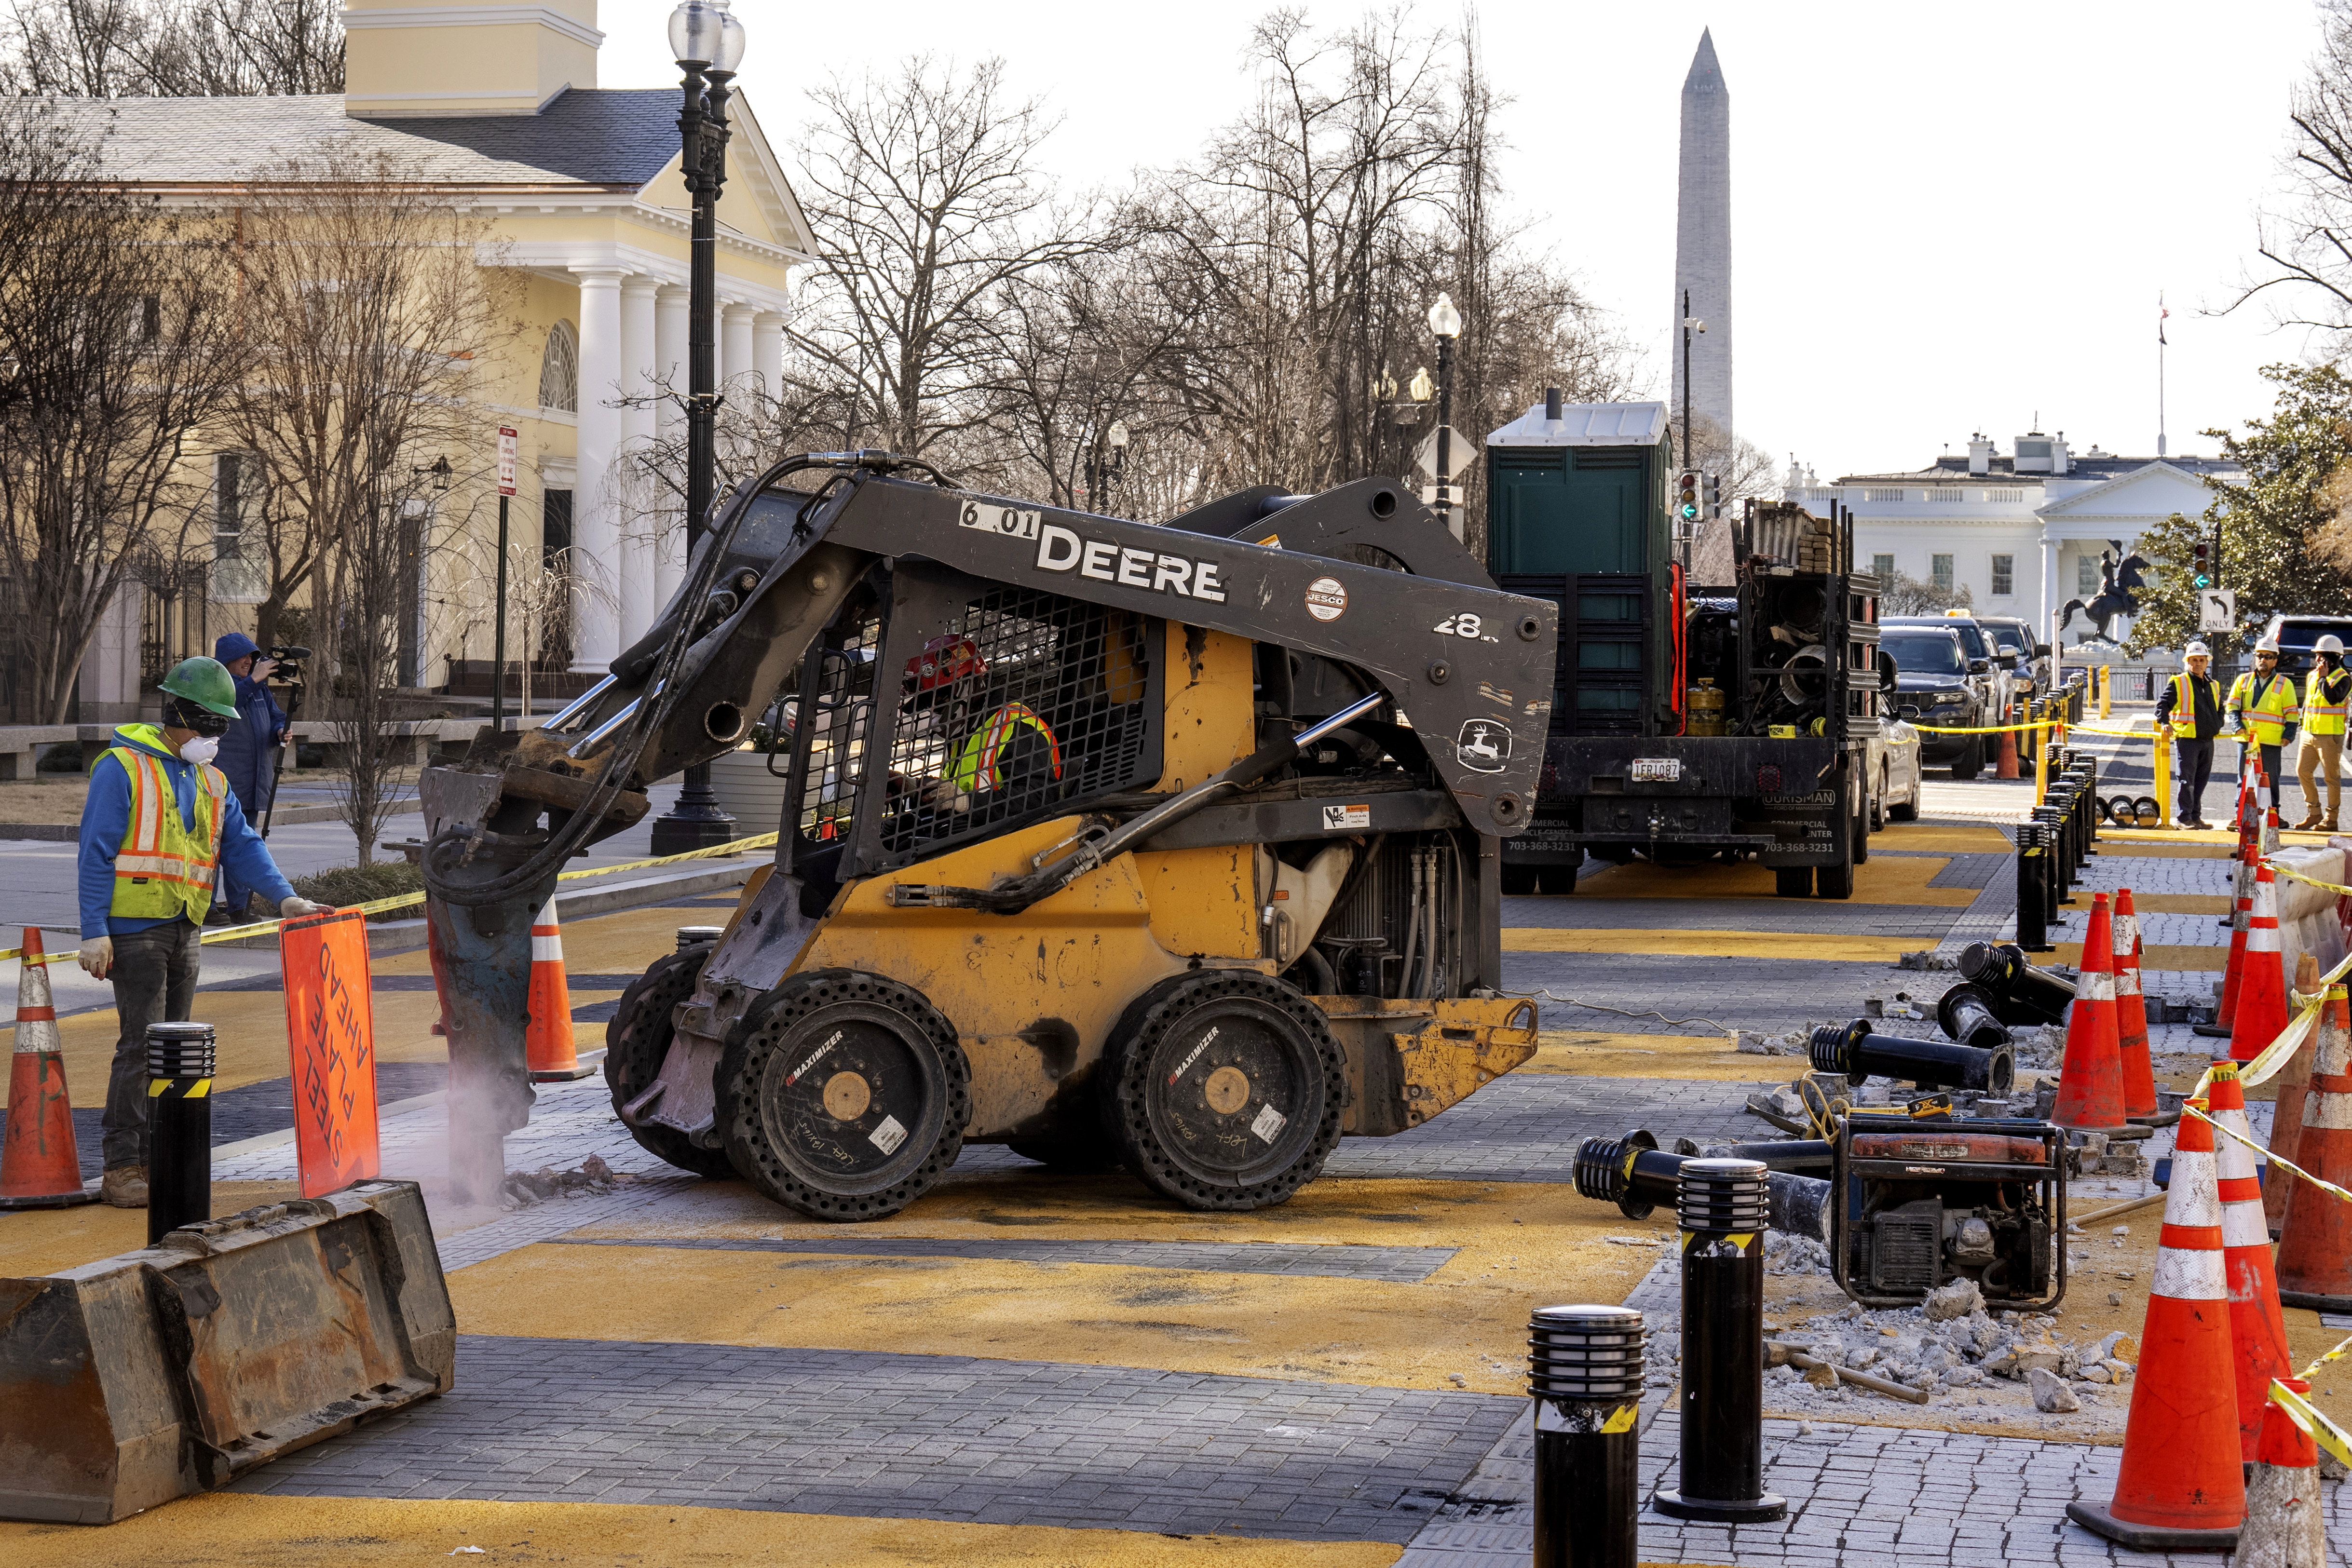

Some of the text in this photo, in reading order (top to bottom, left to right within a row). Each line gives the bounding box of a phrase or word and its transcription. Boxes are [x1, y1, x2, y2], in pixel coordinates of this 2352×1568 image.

[501, 447, 514, 455] STANDING
[503, 457, 515, 465] PARKING
[1037, 525, 1225, 602] DEERE
[1307, 593, 1344, 606] JESCO
[1509, 841, 1576, 851] 703-368-3231
[1765, 843, 1834, 852] 703-368-3231
[1175, 1026, 1219, 1078] MAXIMIZER
[304, 1044, 344, 1168] STEEL
